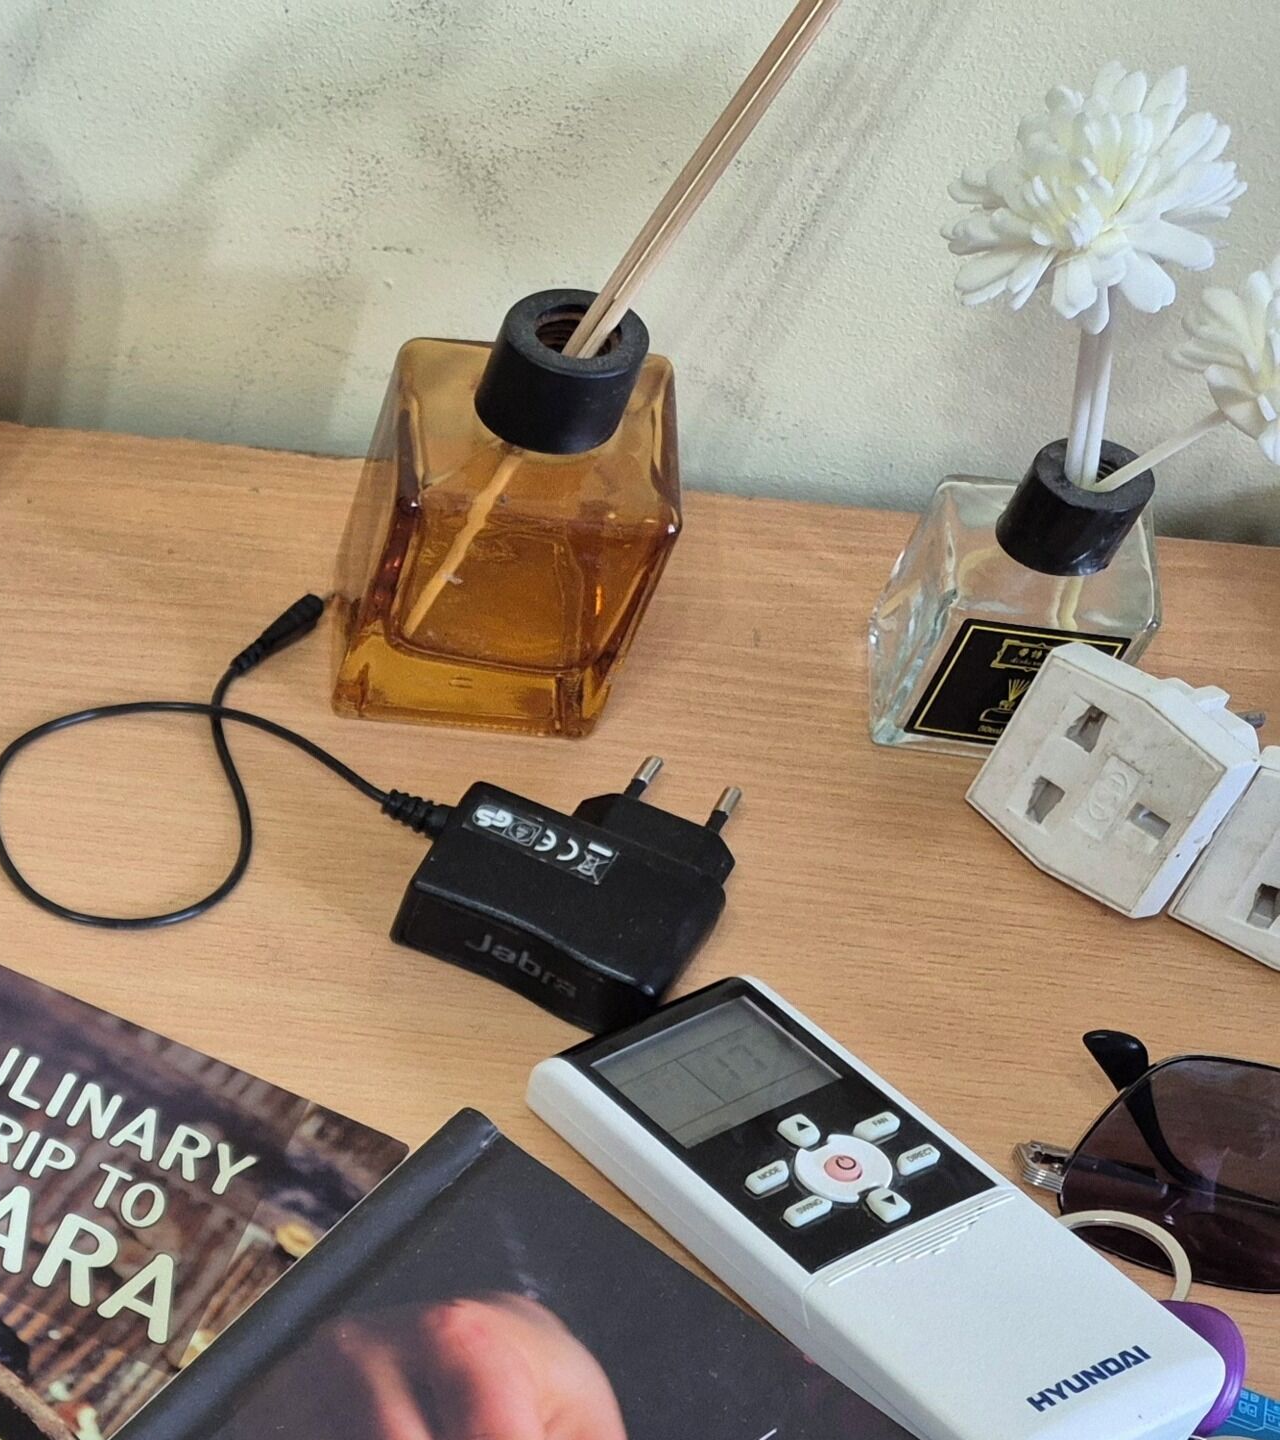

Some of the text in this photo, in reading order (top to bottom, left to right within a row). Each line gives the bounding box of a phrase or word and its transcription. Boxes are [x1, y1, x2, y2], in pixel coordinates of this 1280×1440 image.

[463, 933, 578, 999] Jabra
[758, 1166, 783, 1182] MODE
[906, 1147, 934, 1162] DIRECT
[92, 1161, 166, 1229] TO
[1026, 1345, 1152, 1412] HYUNDAI
